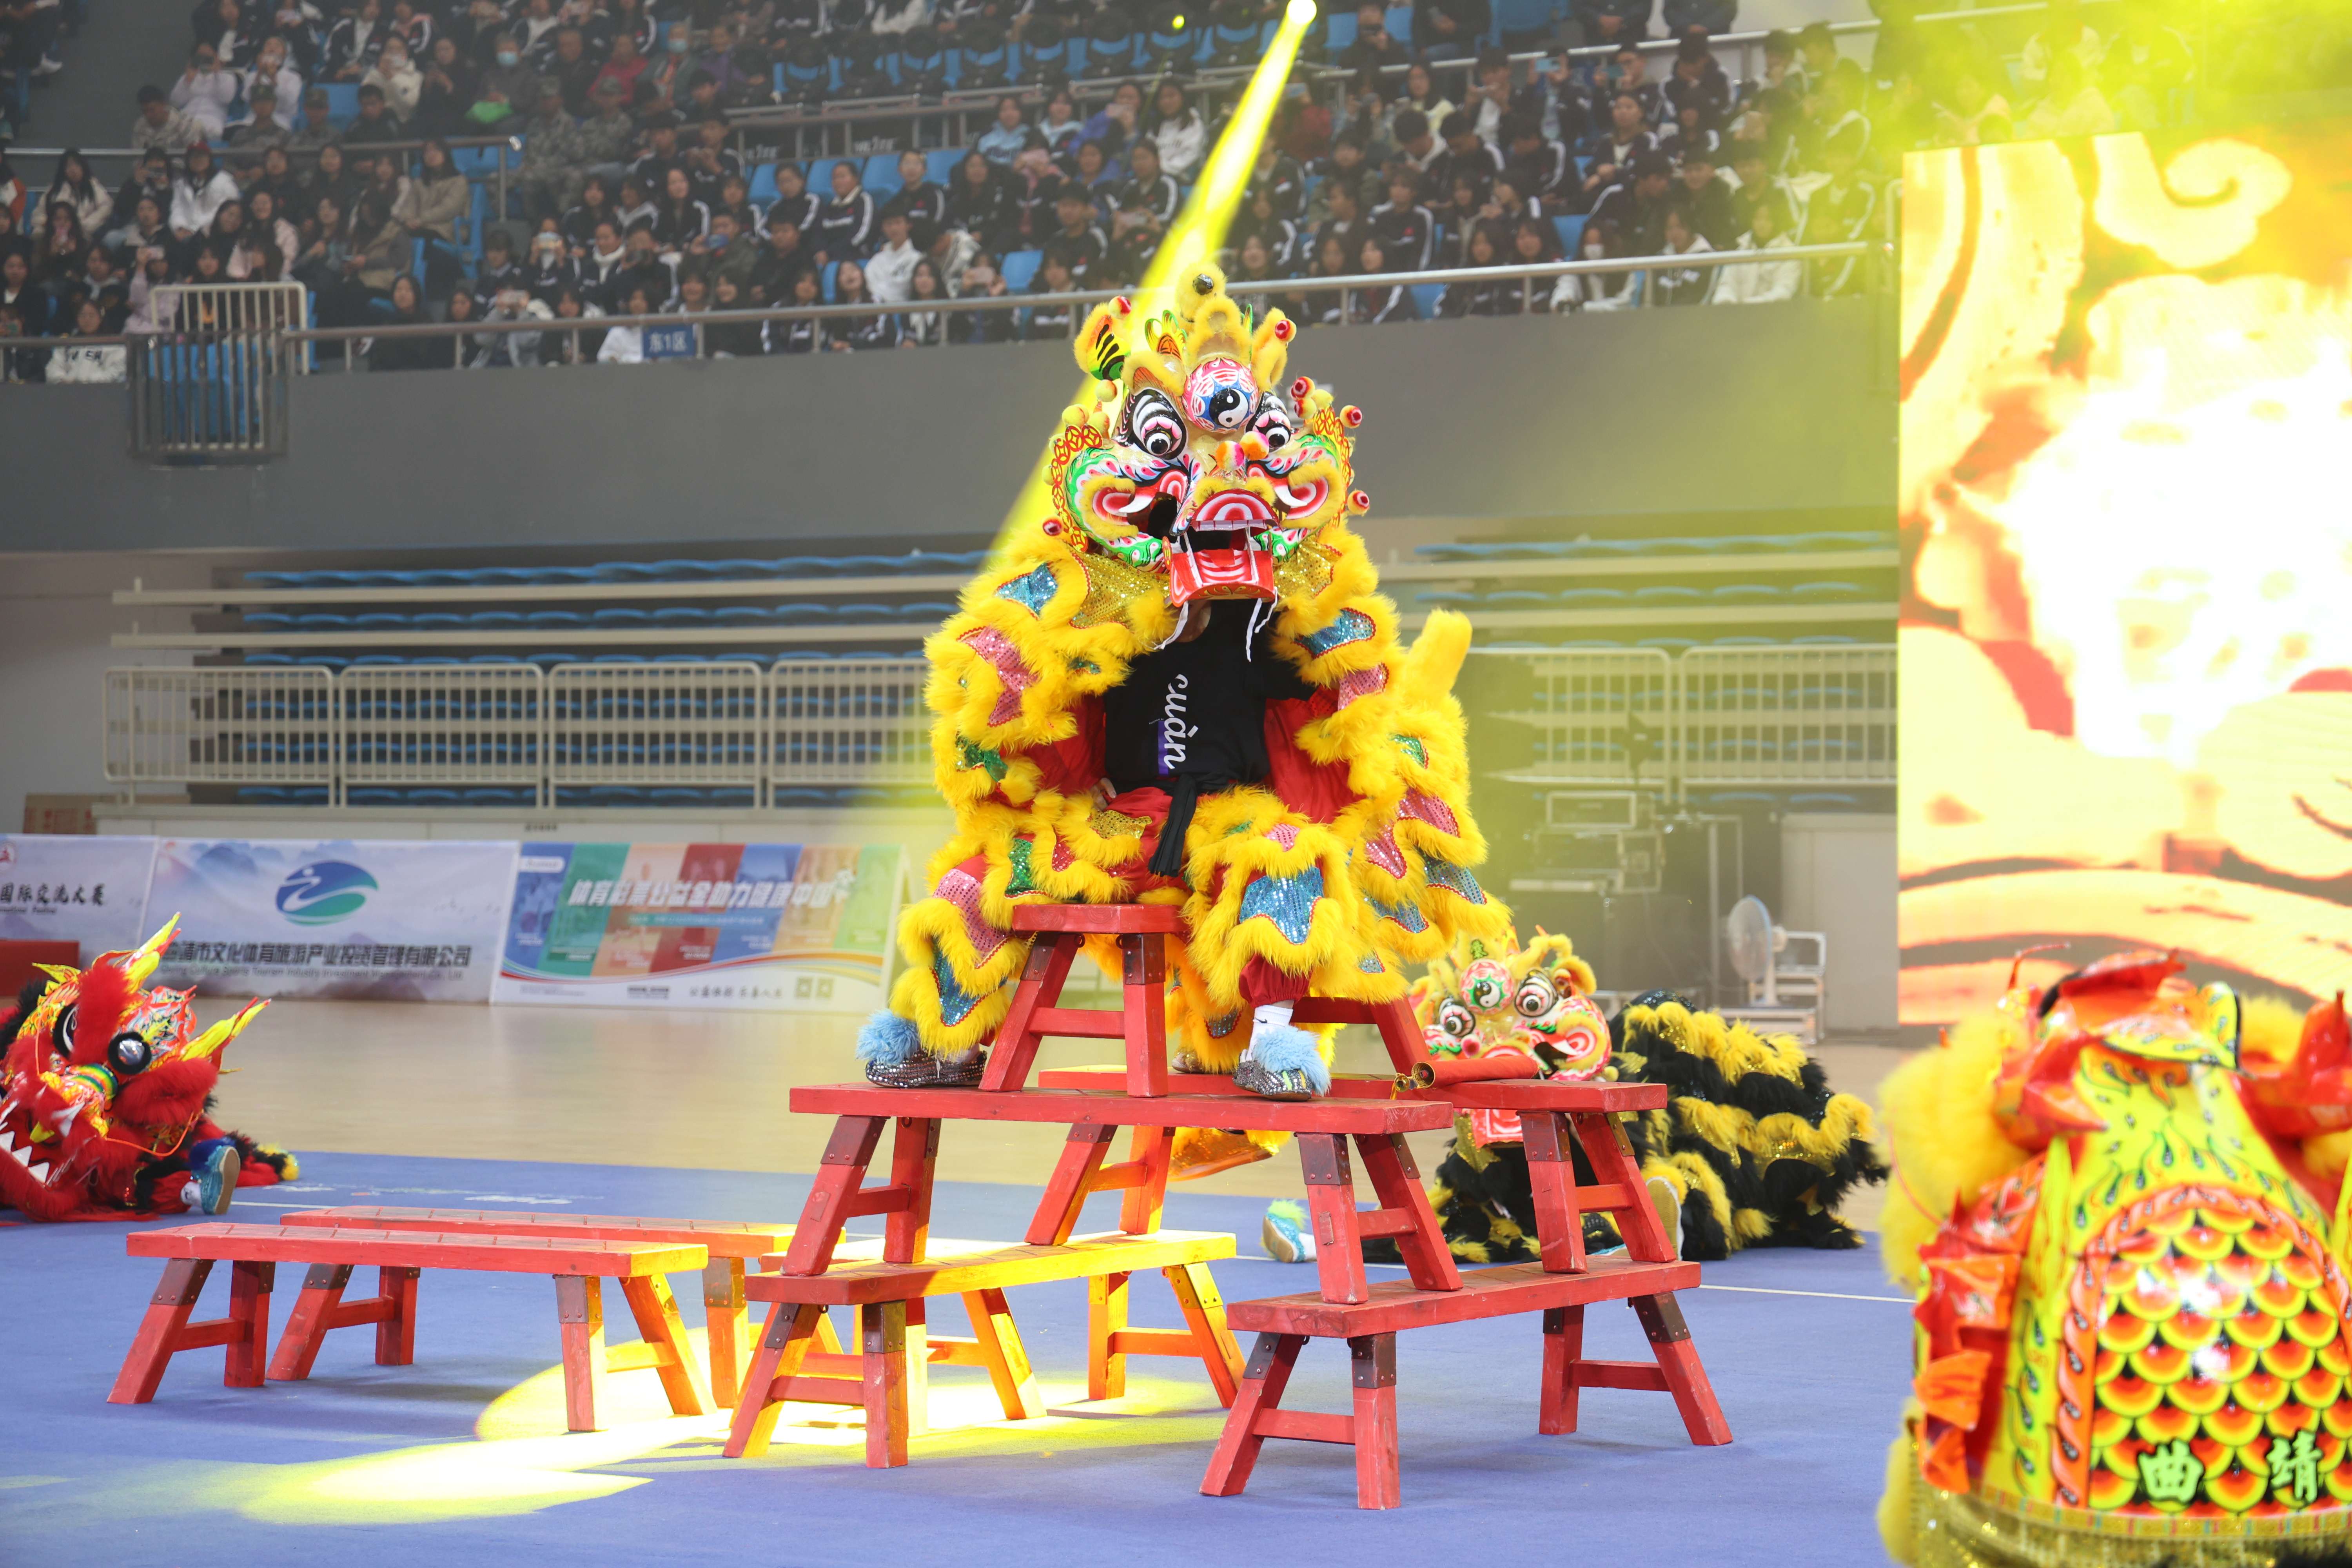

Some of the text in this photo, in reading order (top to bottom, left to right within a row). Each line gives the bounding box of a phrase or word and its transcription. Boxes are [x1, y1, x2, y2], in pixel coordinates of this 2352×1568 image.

[568, 878, 836, 909] 体育彩票公益金助力健康中国
[2138, 1429, 2323, 1503] 曲靖
